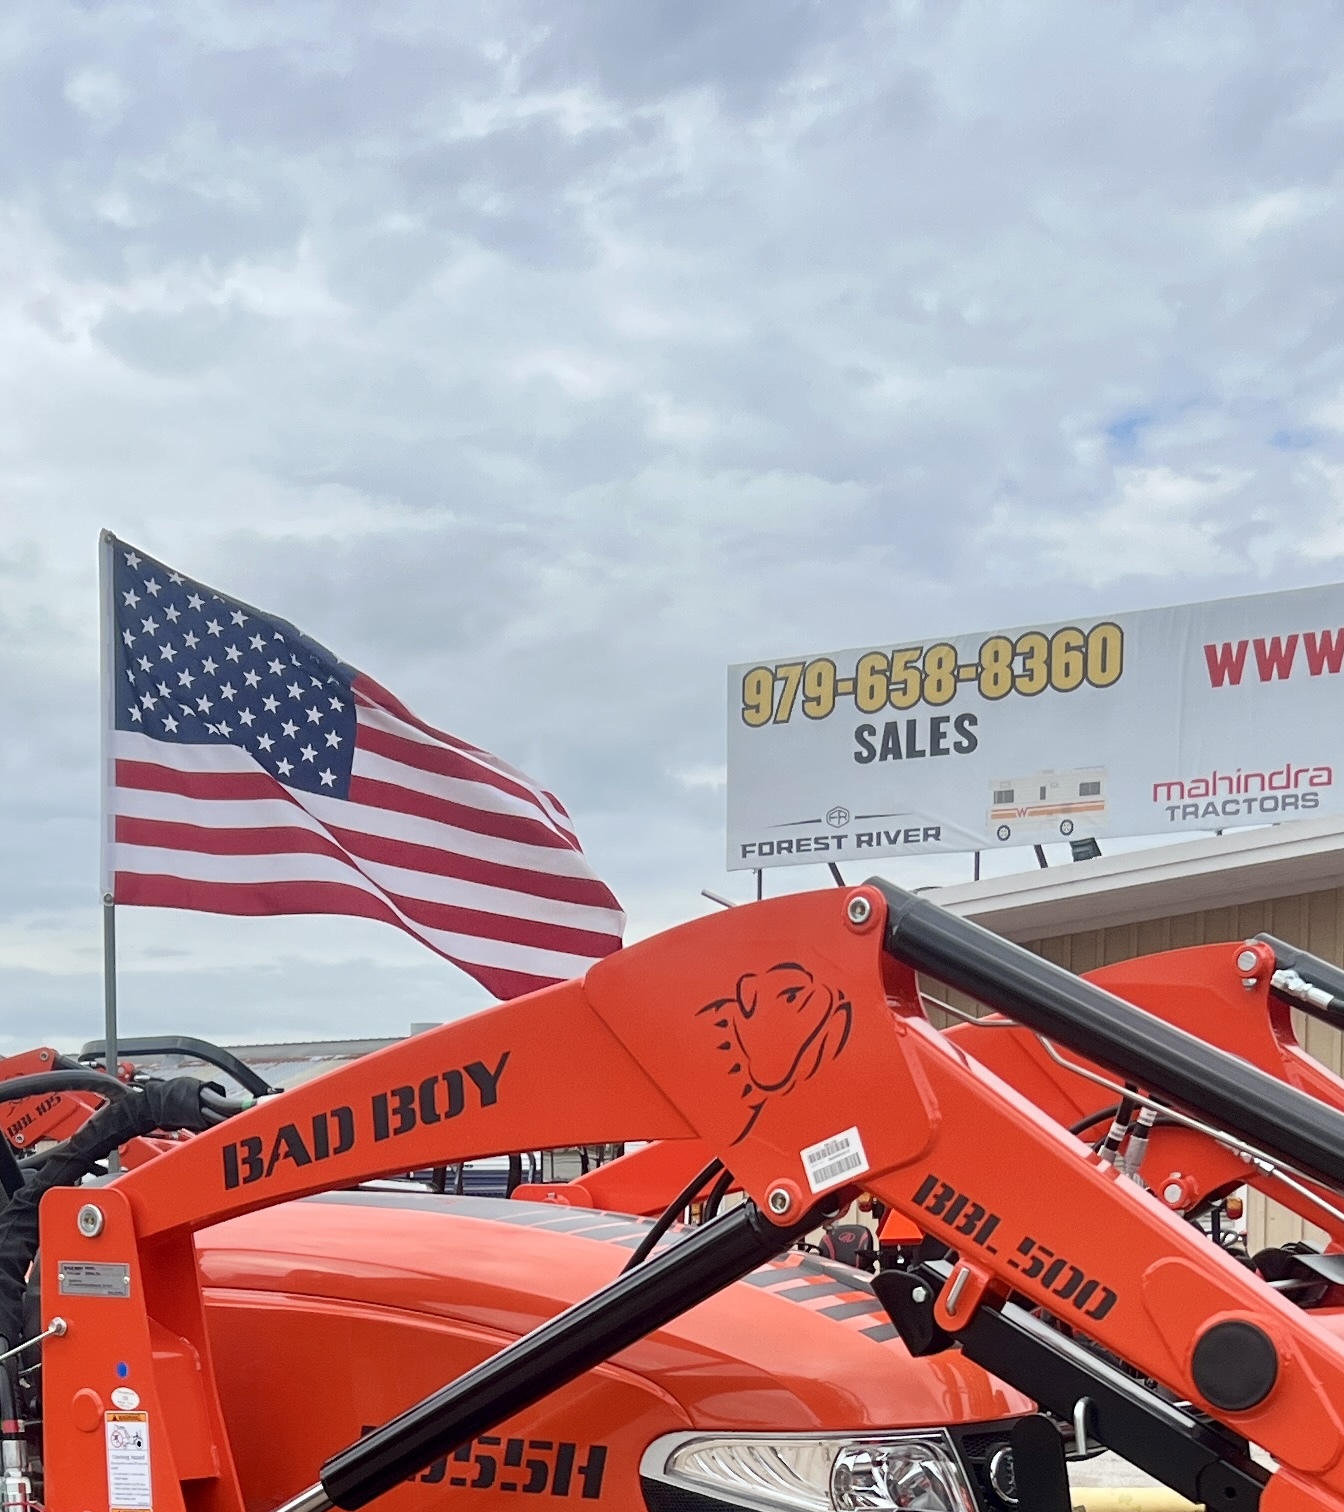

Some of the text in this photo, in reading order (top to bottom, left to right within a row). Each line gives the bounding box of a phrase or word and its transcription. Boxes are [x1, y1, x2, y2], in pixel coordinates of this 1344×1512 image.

[741, 620, 1126, 729] 979-658-8360
[853, 712, 979, 765] SALES
[1152, 762, 1334, 803] mahindra
[1164, 791, 1321, 823] TRACTORS
[740, 825, 942, 860] FOREST RIVER
[222, 1050, 511, 1192] BAD BOY
[911, 1173, 1119, 1321] BBL 500
